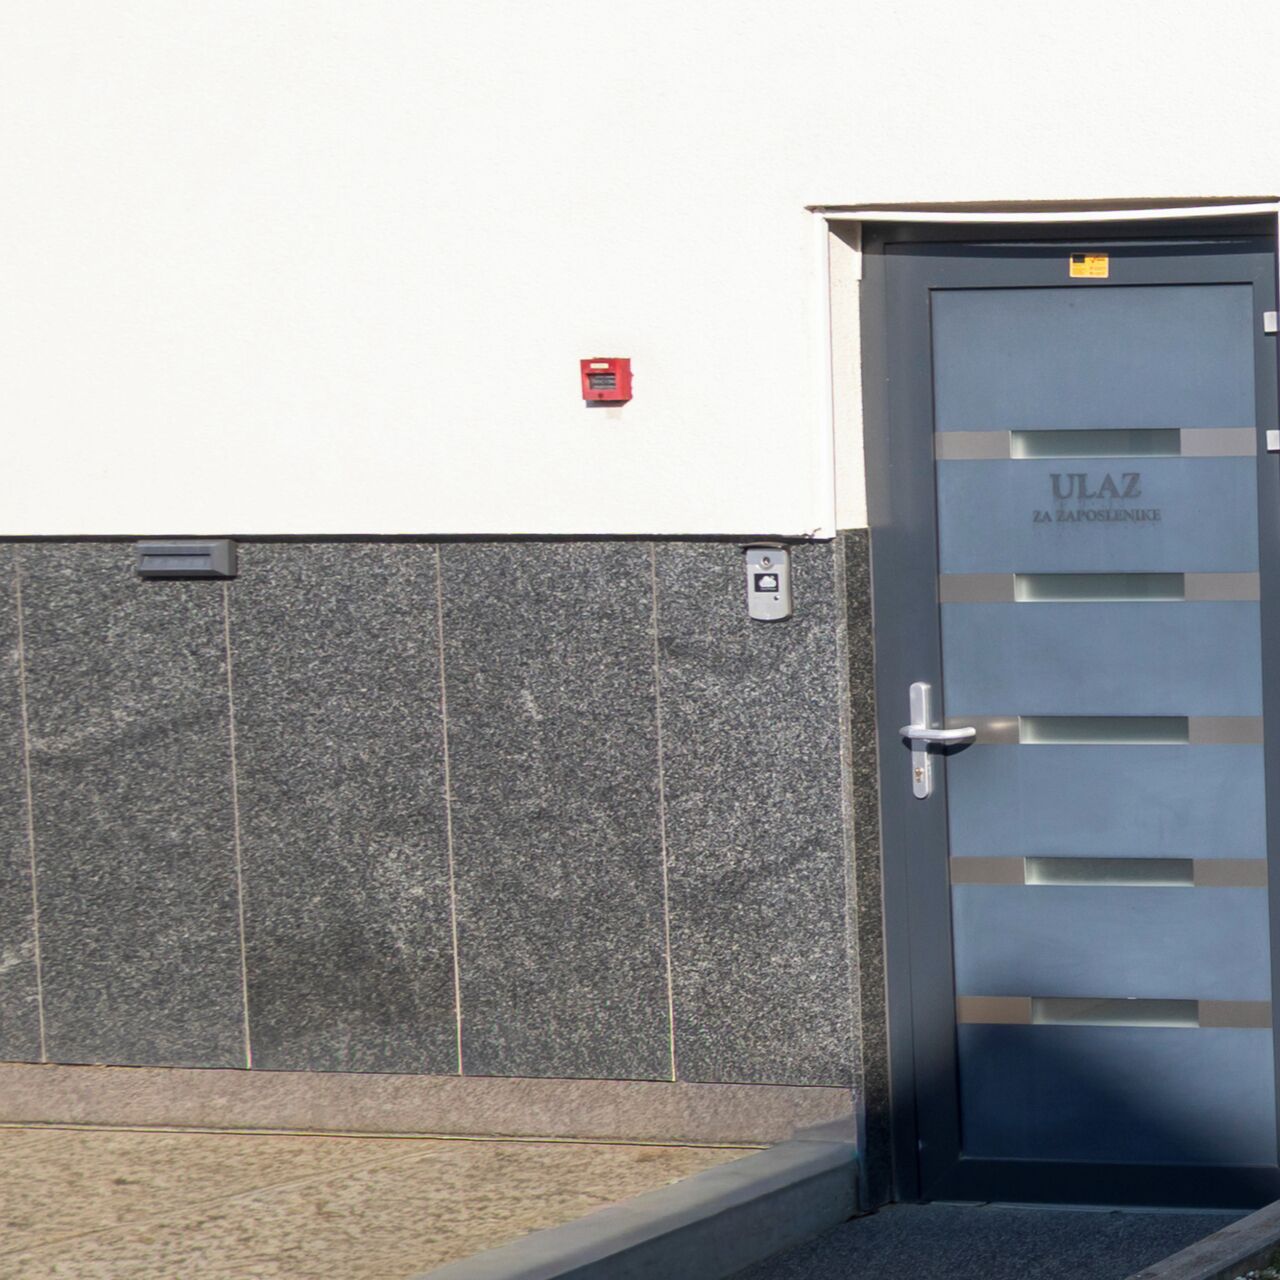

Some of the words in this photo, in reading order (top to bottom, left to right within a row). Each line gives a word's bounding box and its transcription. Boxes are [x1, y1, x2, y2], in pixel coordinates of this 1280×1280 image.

[1050, 473, 1142, 499] ULAZ
[1033, 510, 1052, 522] ZA
[1056, 509, 1161, 522] ZAPOSLENIKE
